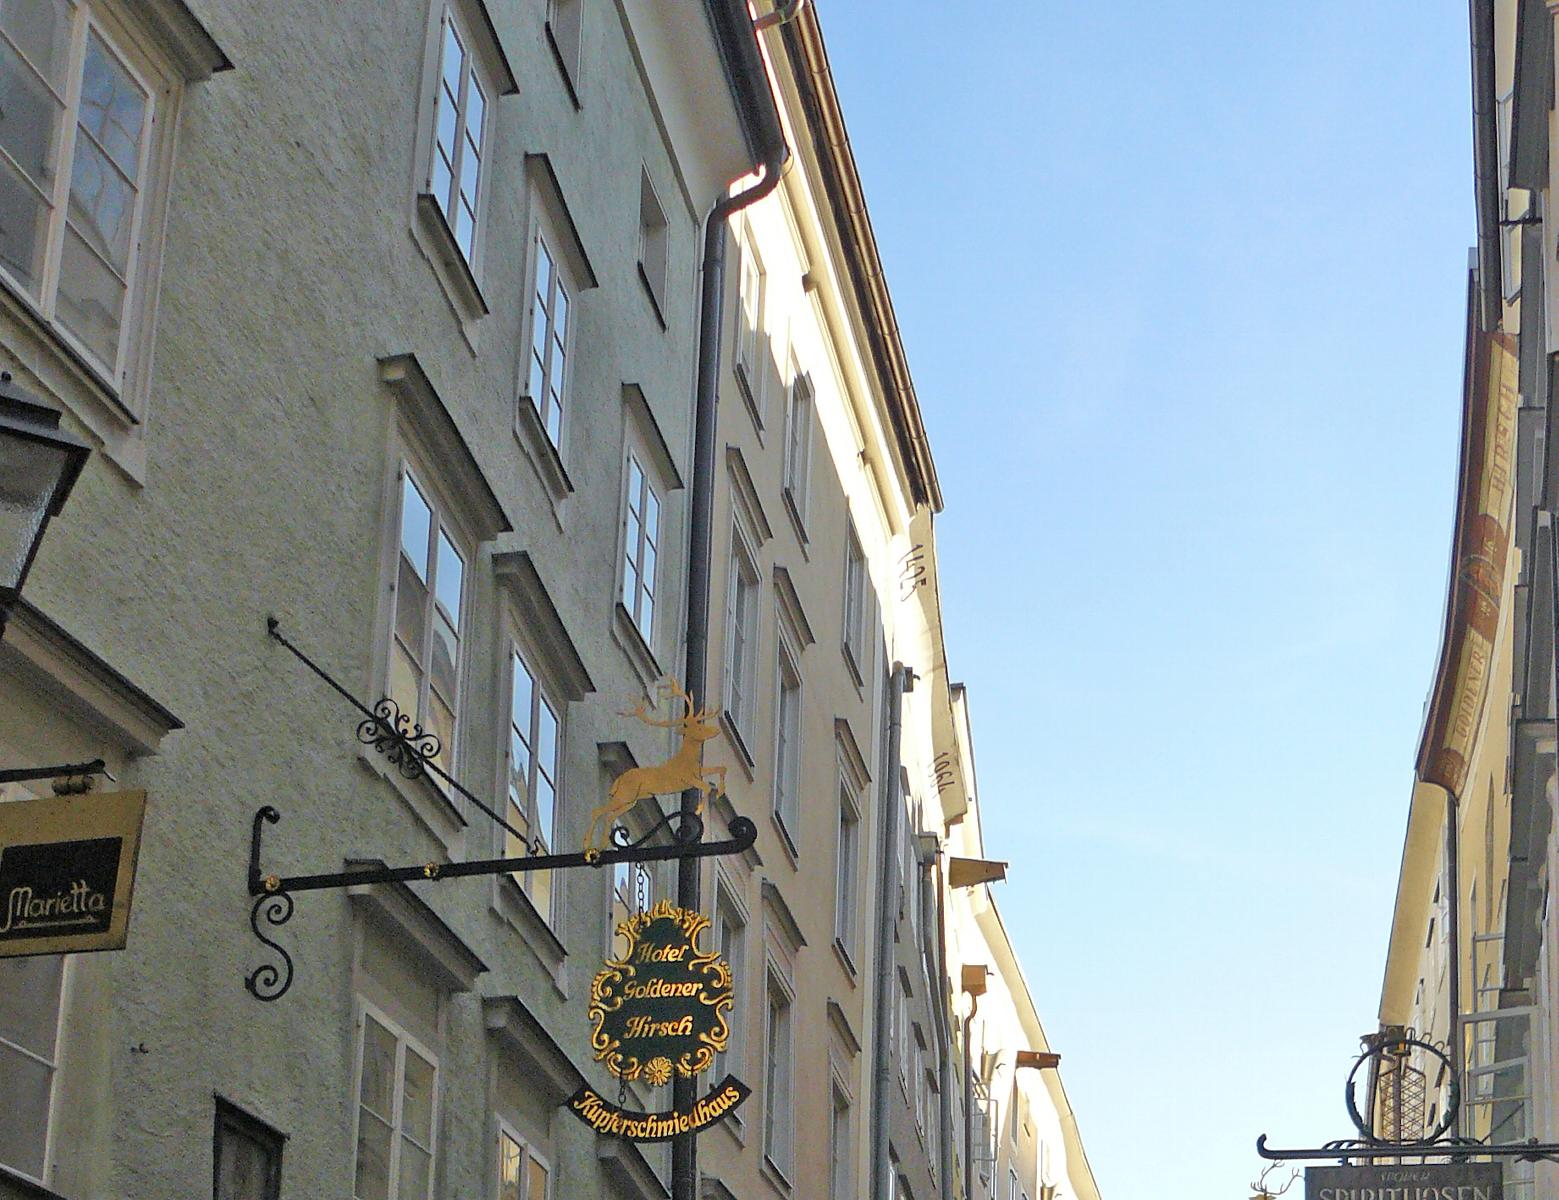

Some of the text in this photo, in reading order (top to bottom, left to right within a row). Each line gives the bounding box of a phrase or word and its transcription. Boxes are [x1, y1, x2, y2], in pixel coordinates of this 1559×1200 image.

[0, 880, 105, 932] Marietta
[636, 944, 689, 963] Hotel
[624, 979, 703, 1000] Goldener
[624, 1015, 693, 1039] Hirsch
[574, 1086, 740, 1138] Kupferschmiedhaus
